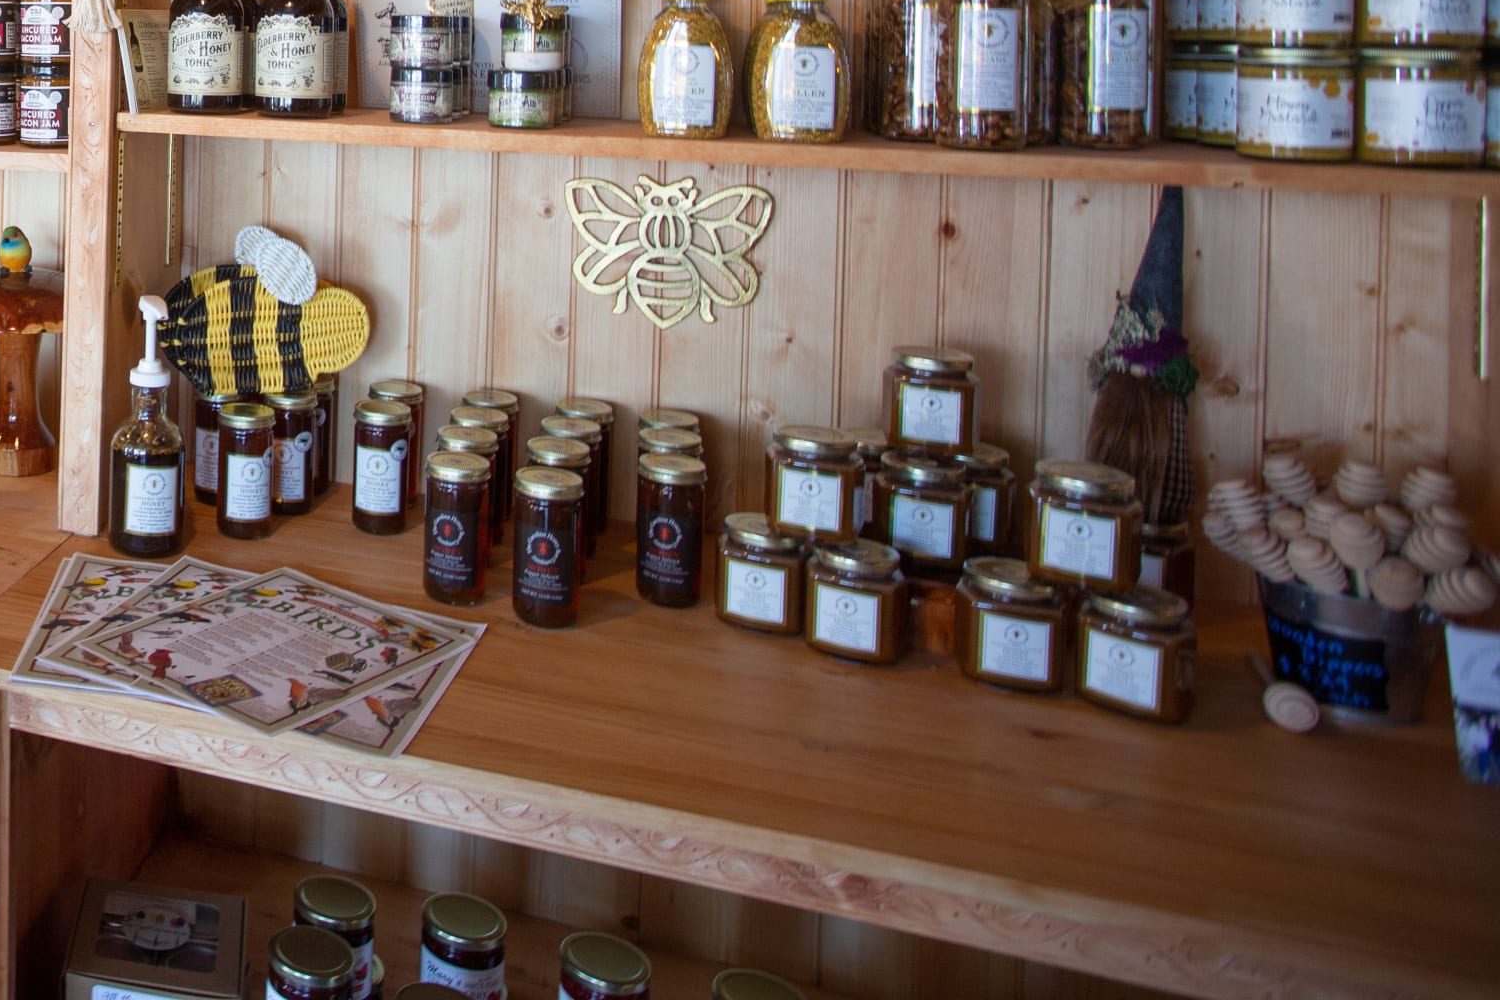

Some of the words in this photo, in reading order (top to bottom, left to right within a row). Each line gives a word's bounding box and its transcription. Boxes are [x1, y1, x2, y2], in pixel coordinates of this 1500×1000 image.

[42, 35, 62, 43] JAM
[172, 31, 223, 53] ELDERBERRY
[257, 31, 306, 53] ELDERBERRY
[188, 48, 196, 56] &
[199, 41, 233, 57] HONEY
[270, 48, 278, 57] &
[281, 42, 317, 58] HONEY
[185, 58, 213, 68] TONIC
[268, 58, 294, 69] TONIC
[41, 120, 60, 128] JAM
[270, 601, 375, 649] BIRDS
